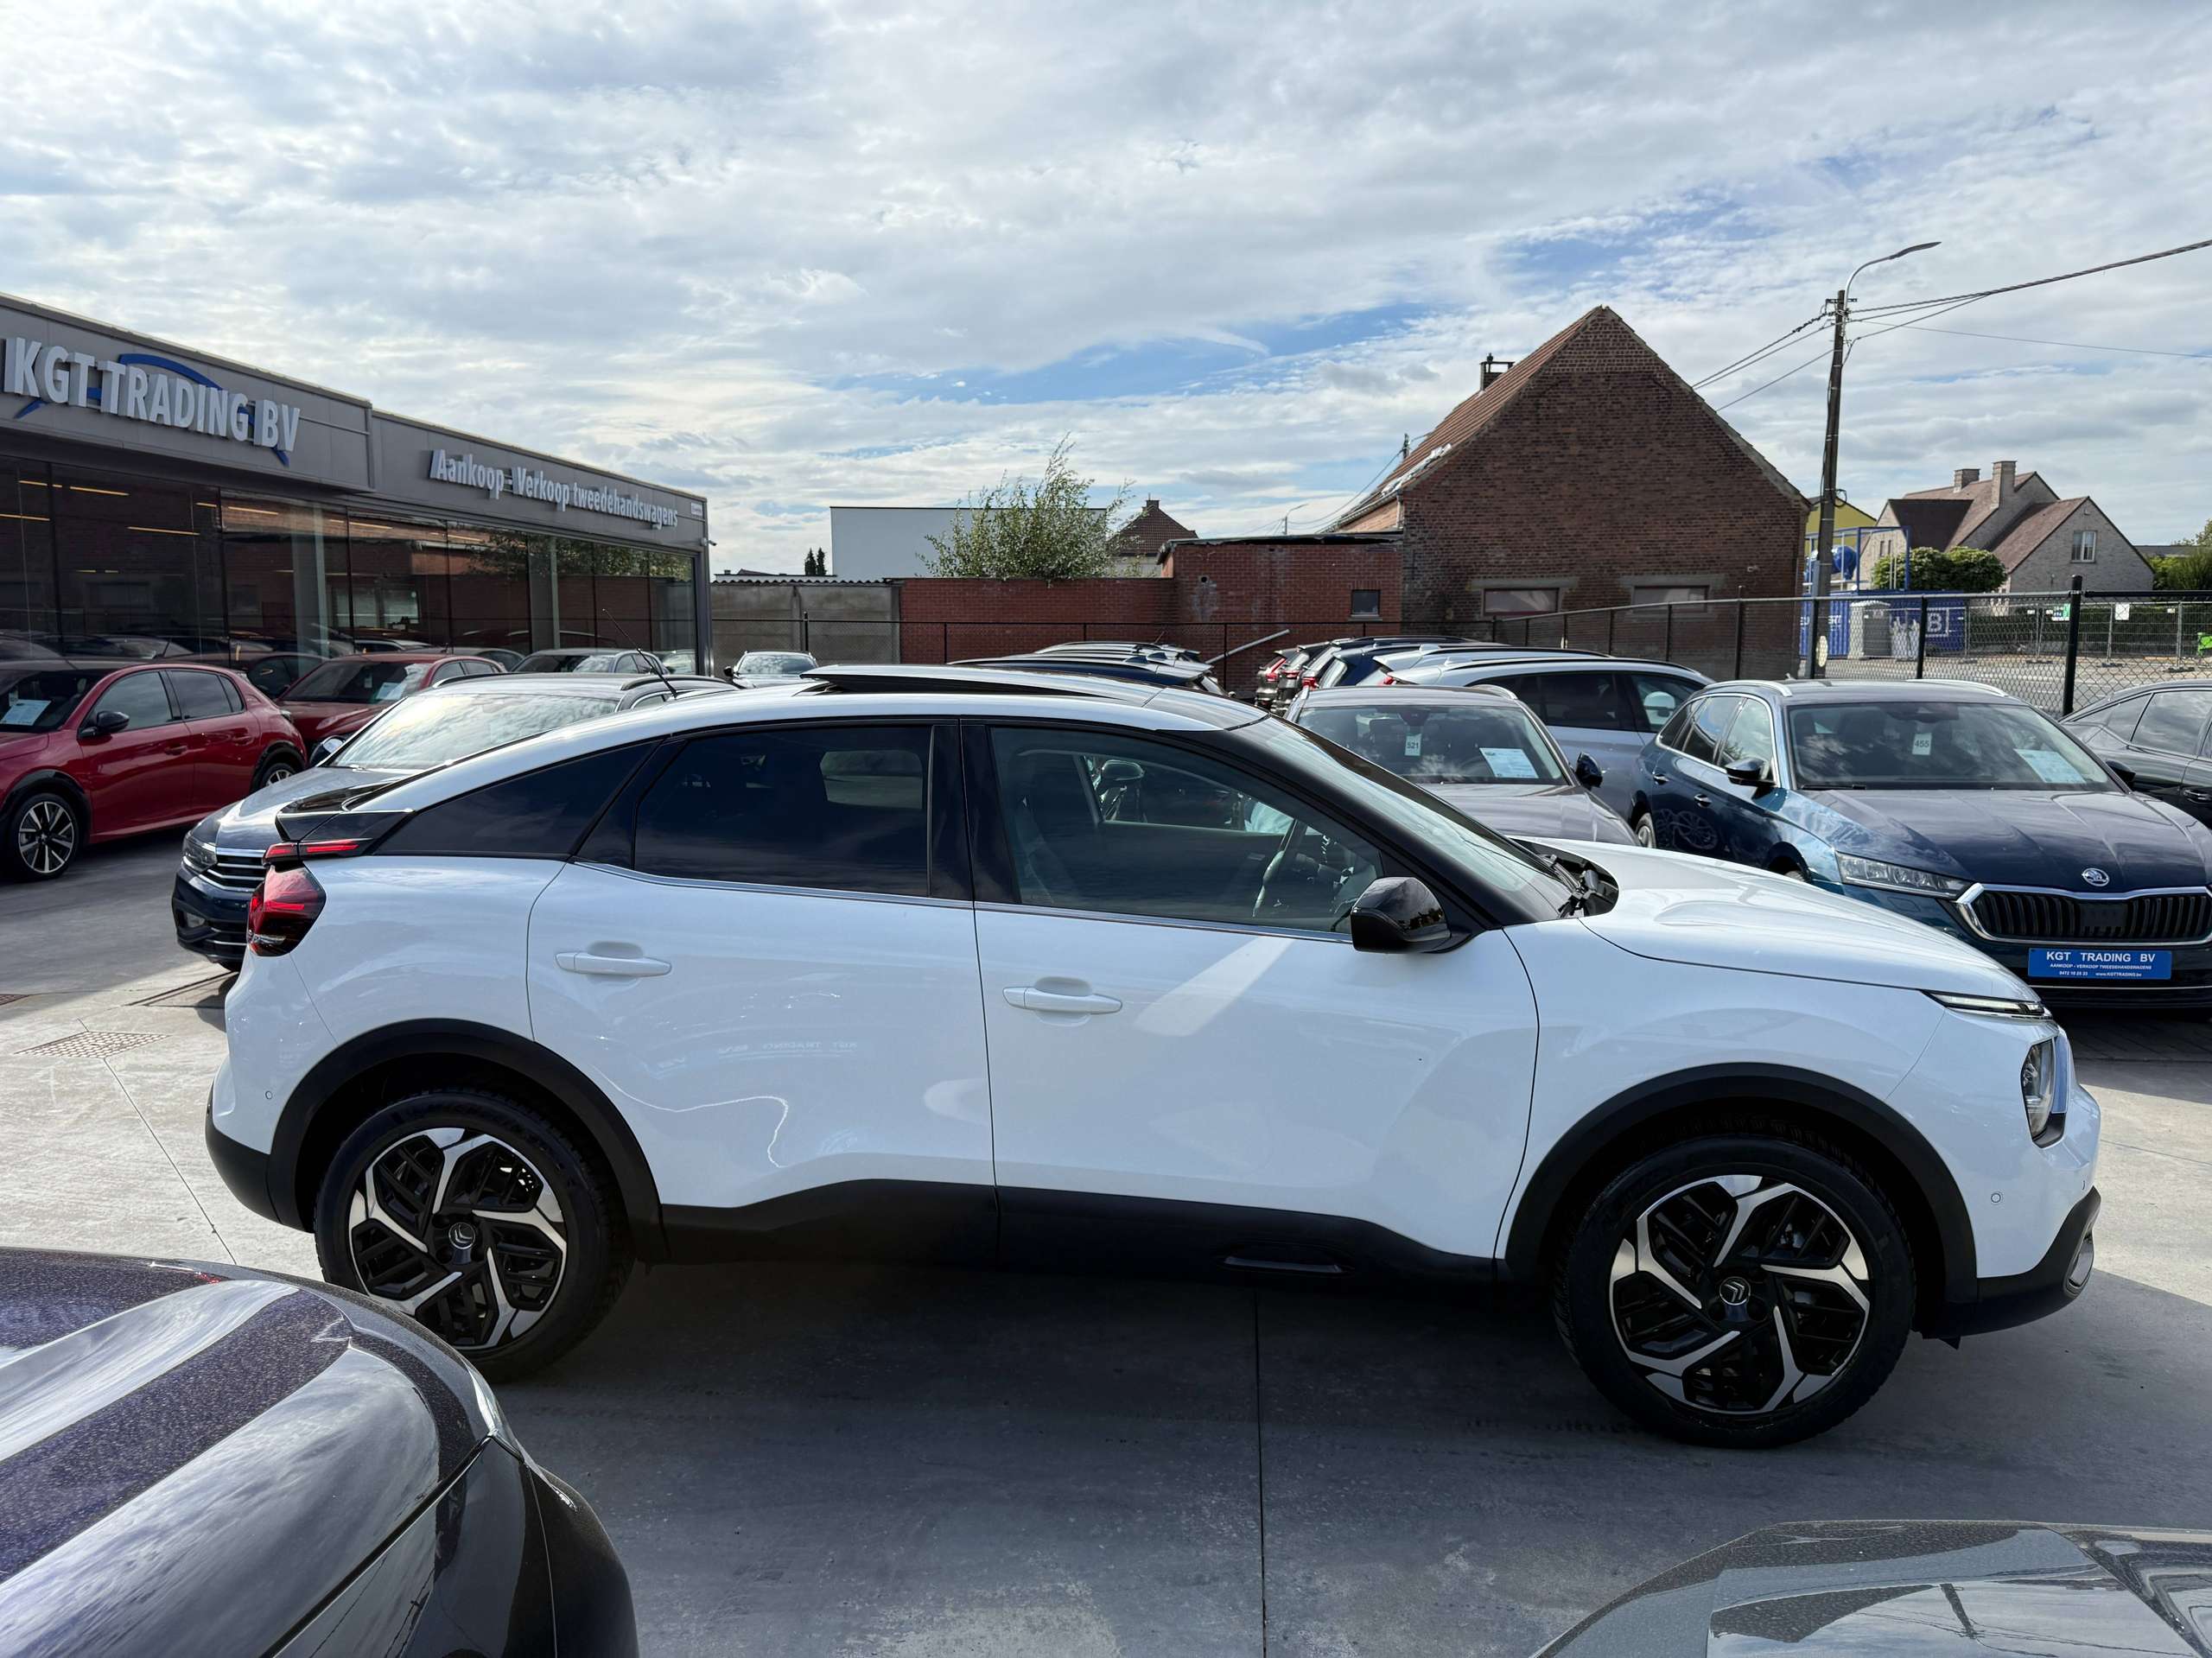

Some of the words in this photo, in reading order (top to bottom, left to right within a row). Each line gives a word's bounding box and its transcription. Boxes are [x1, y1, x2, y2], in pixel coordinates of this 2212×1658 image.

[3, 337, 95, 407] KGT
[97, 359, 250, 441] TRADING
[253, 399, 301, 452] BV
[430, 449, 505, 499] Aankoop
[512, 467, 569, 511] Verkoop
[574, 482, 678, 530] tweedehandswagens
[2046, 951, 2071, 961] KGT
[2081, 952, 2132, 962] TRADING
[2139, 953, 2156, 962] BV
